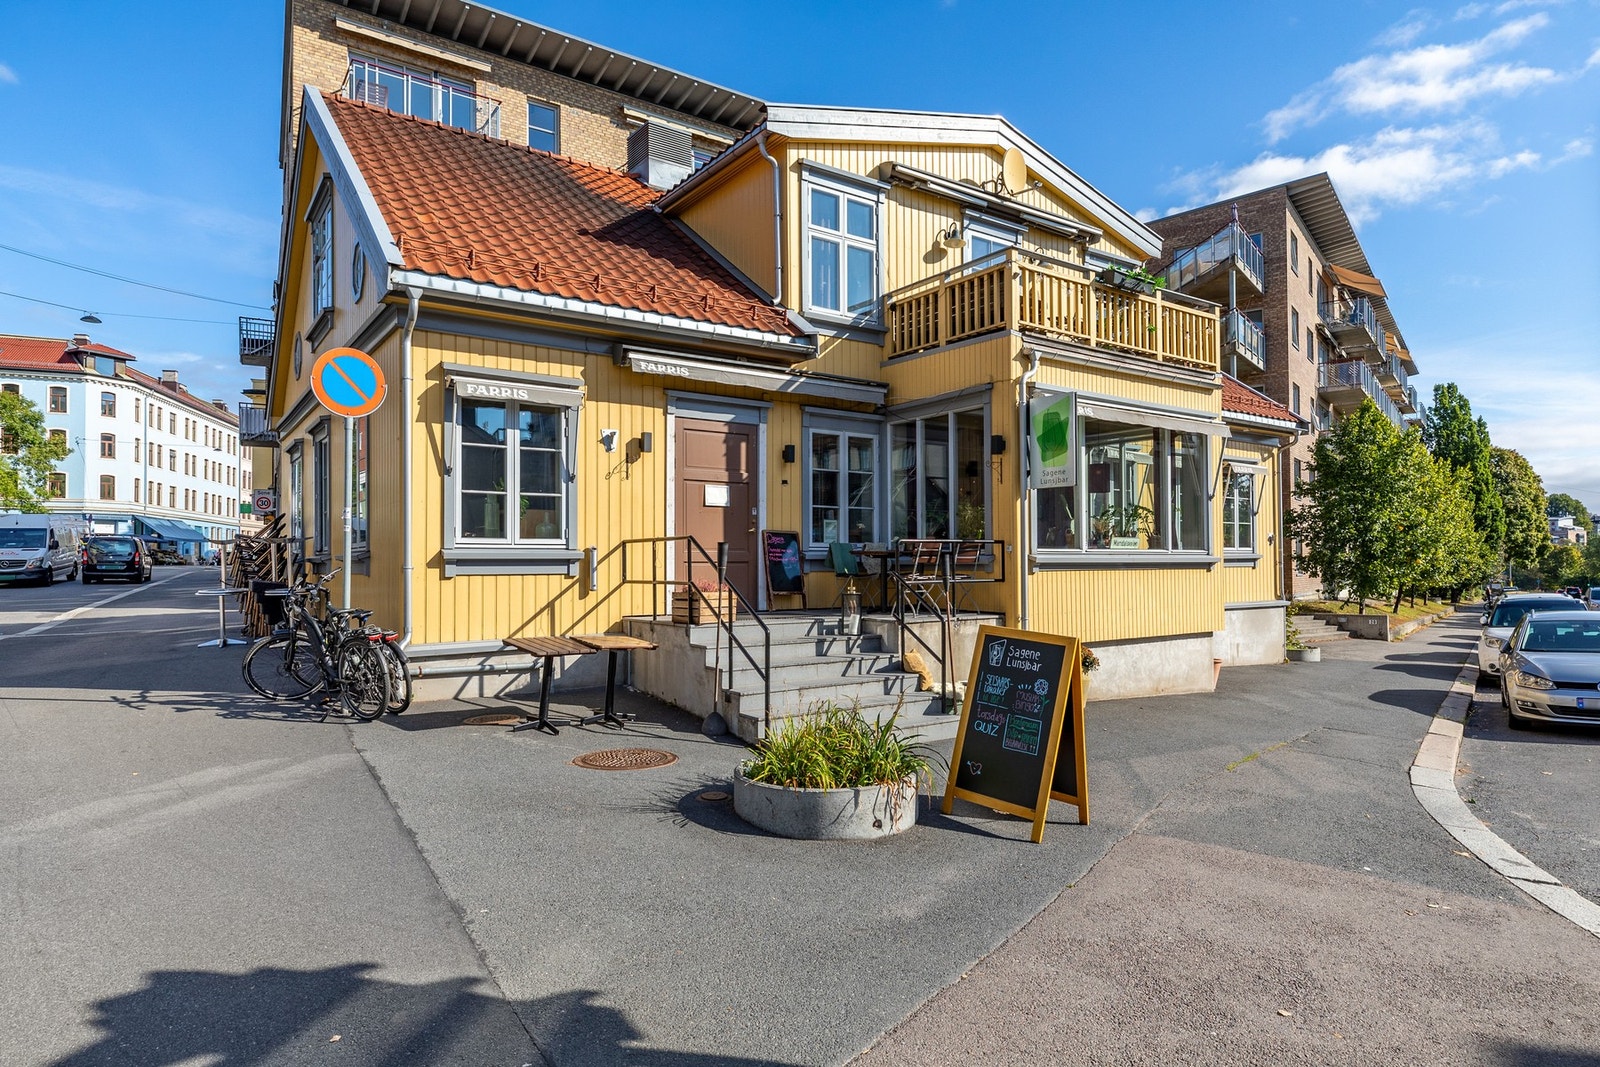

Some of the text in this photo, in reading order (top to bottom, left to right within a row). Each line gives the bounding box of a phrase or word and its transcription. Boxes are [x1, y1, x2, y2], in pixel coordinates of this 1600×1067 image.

[640, 361, 690, 376] FARRIS
[466, 383, 529, 400] FARRIS
[1076, 405, 1094, 417] RIS
[1042, 469, 1066, 477] Sagene
[1040, 477, 1068, 485] Lunsjbar
[259, 499, 269, 507] 30
[1008, 645, 1041, 660] Sagene
[1006, 656, 1042, 672] Lunsjbar
